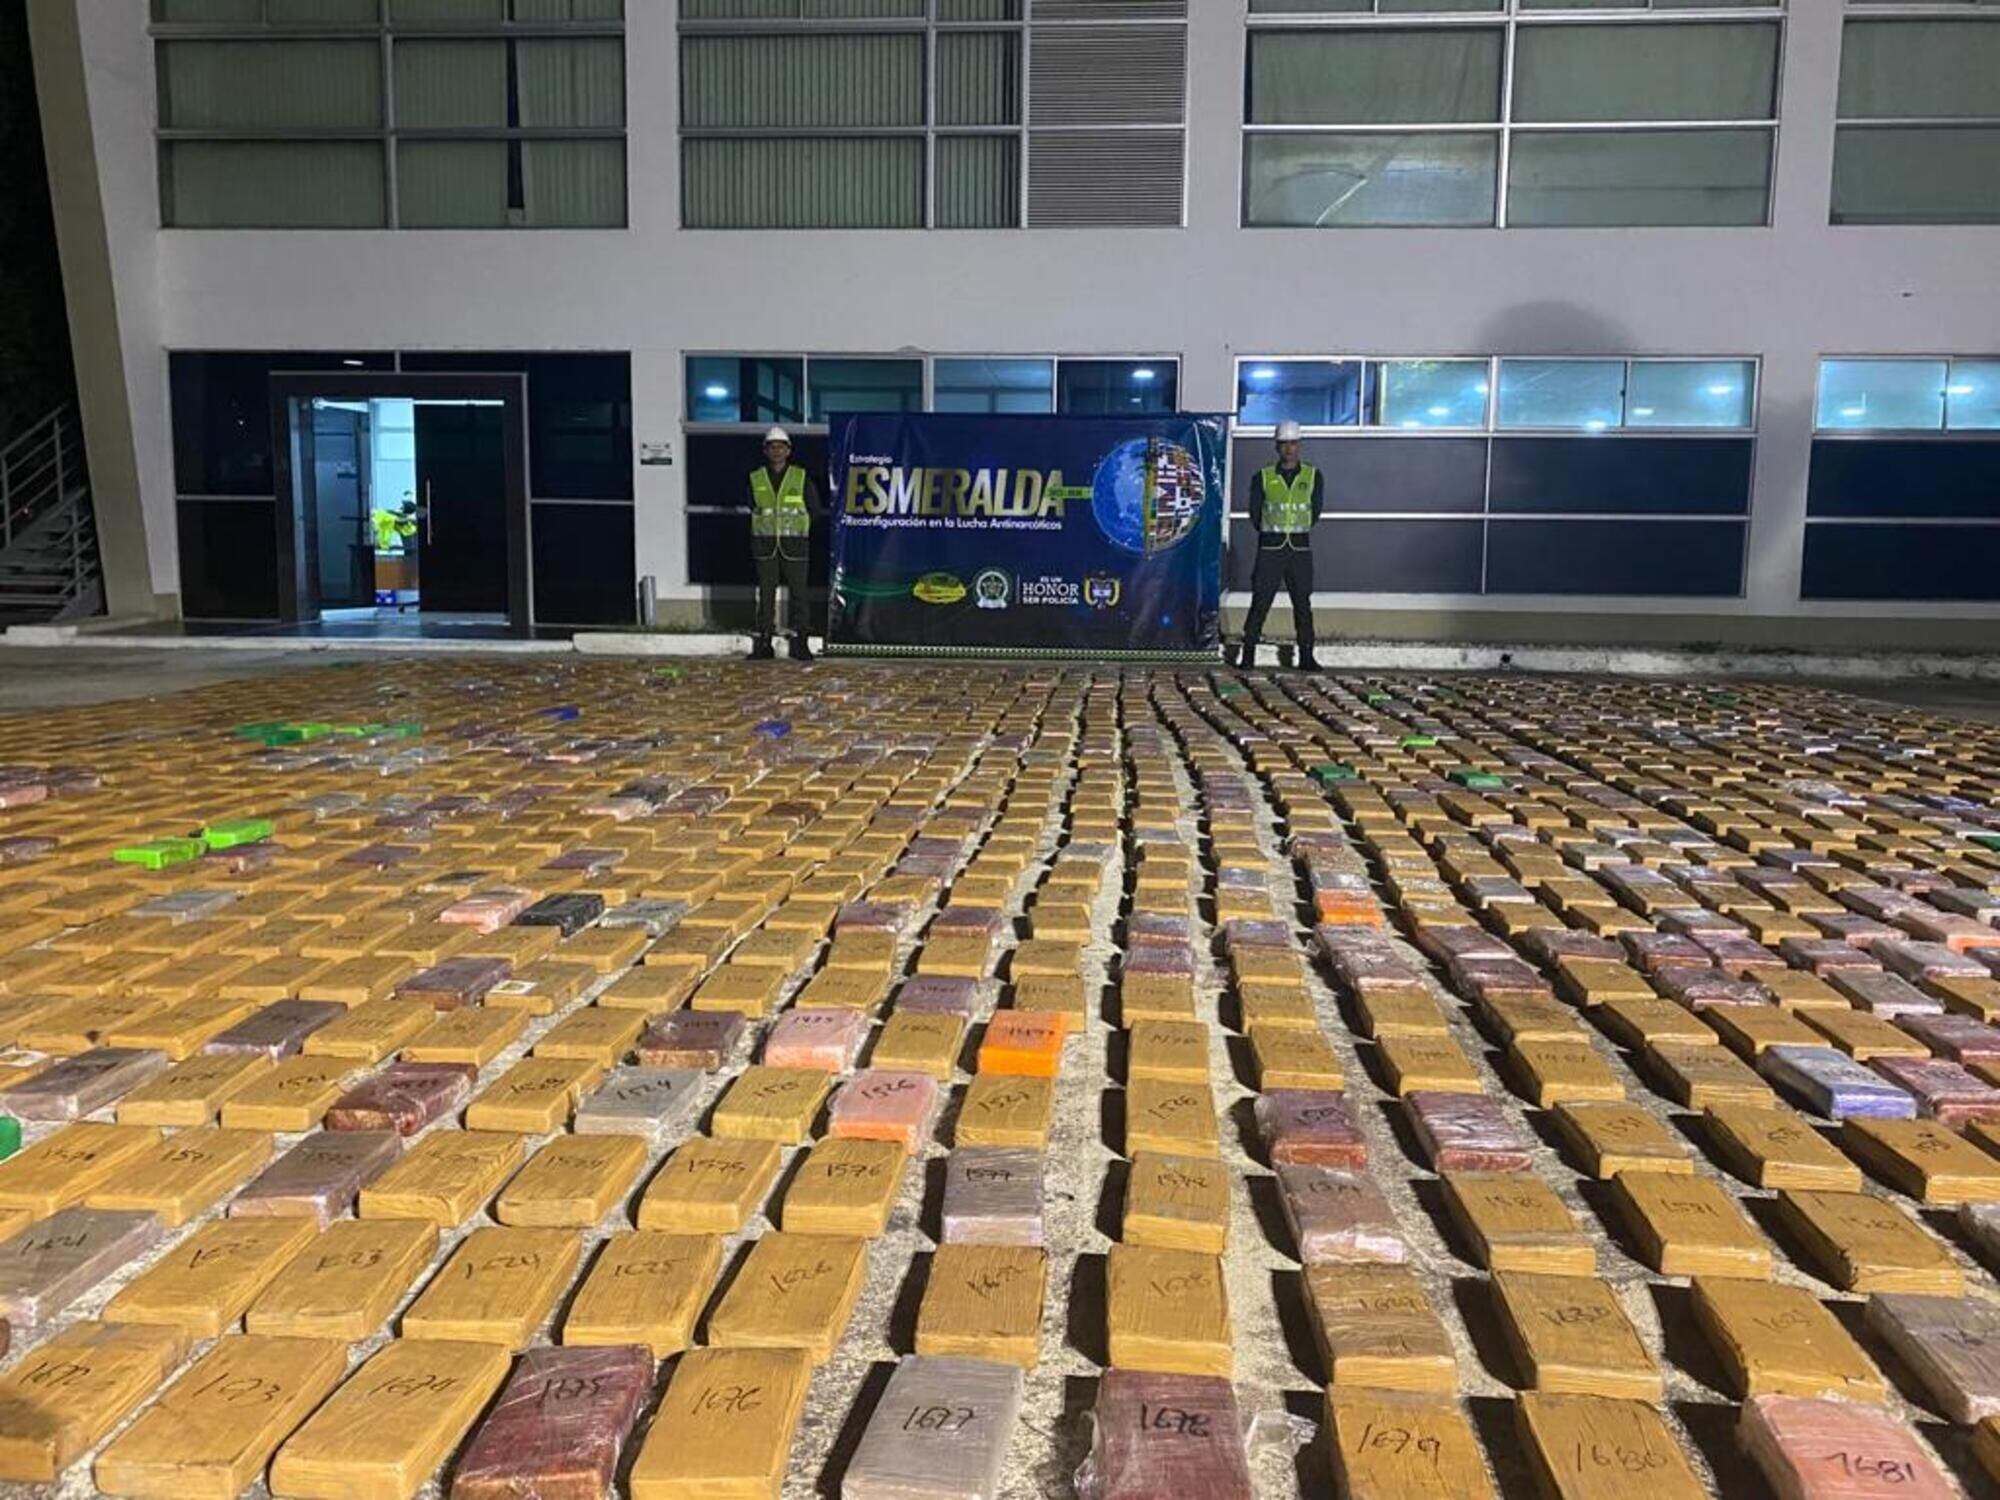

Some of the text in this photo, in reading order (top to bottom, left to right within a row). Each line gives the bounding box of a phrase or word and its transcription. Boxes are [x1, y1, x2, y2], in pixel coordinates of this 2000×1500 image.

[849, 454, 893, 466] Estrategia
[845, 466, 1065, 517] ESMERALDA
[929, 519, 942, 528] en
[944, 517, 955, 528] la
[957, 517, 987, 528] Lucha
[990, 517, 1062, 530] Antinarcóticos
[1023, 583, 1079, 596] HONOR
[861, 1078, 916, 1101] 1526
[826, 1163, 882, 1178] 1576
[965, 1167, 1014, 1182] 1577
[541, 1376, 606, 1402] 1675
[692, 1386, 763, 1416] 1676
[902, 1404, 978, 1432] 1677
[1139, 1402, 1212, 1439] 1678
[1357, 1422, 1441, 1465] 1679
[1825, 1451, 1917, 1485] 1681
